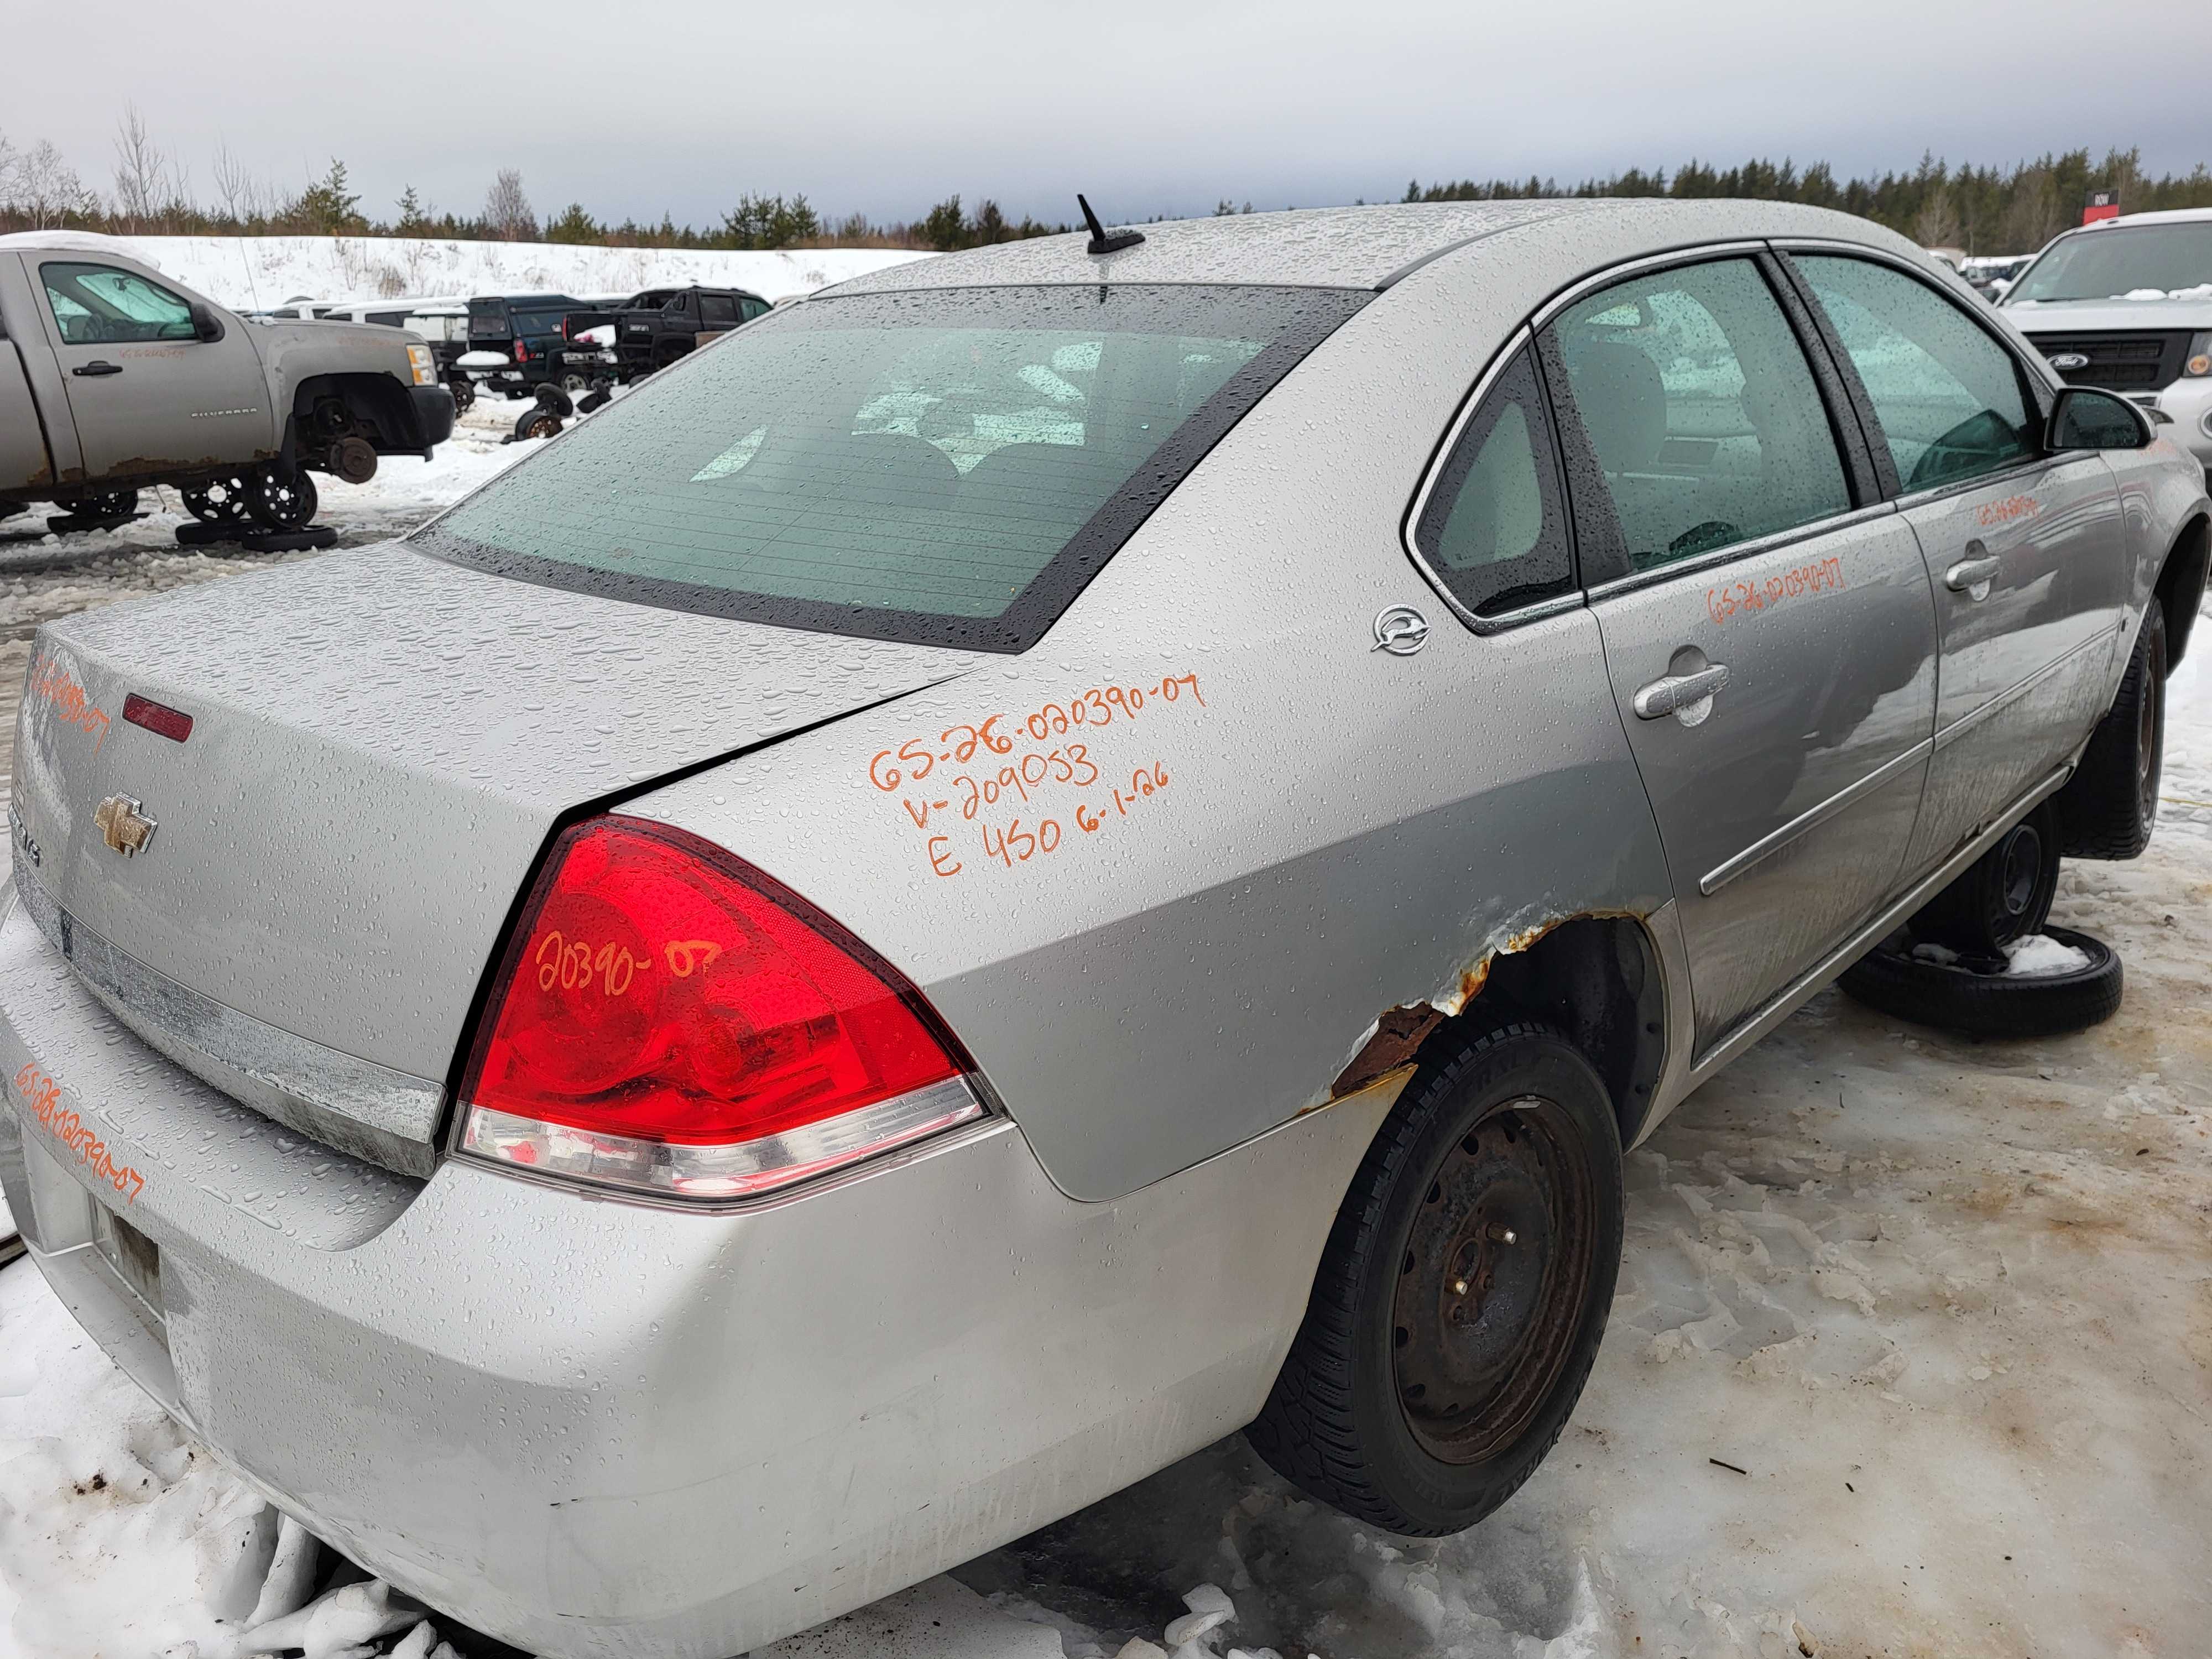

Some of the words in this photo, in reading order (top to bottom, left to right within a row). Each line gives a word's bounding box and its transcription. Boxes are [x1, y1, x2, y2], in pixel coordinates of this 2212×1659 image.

[2055, 356, 2079, 366] Ford
[927, 836, 962, 877] E
[983, 818, 1061, 868] 450
